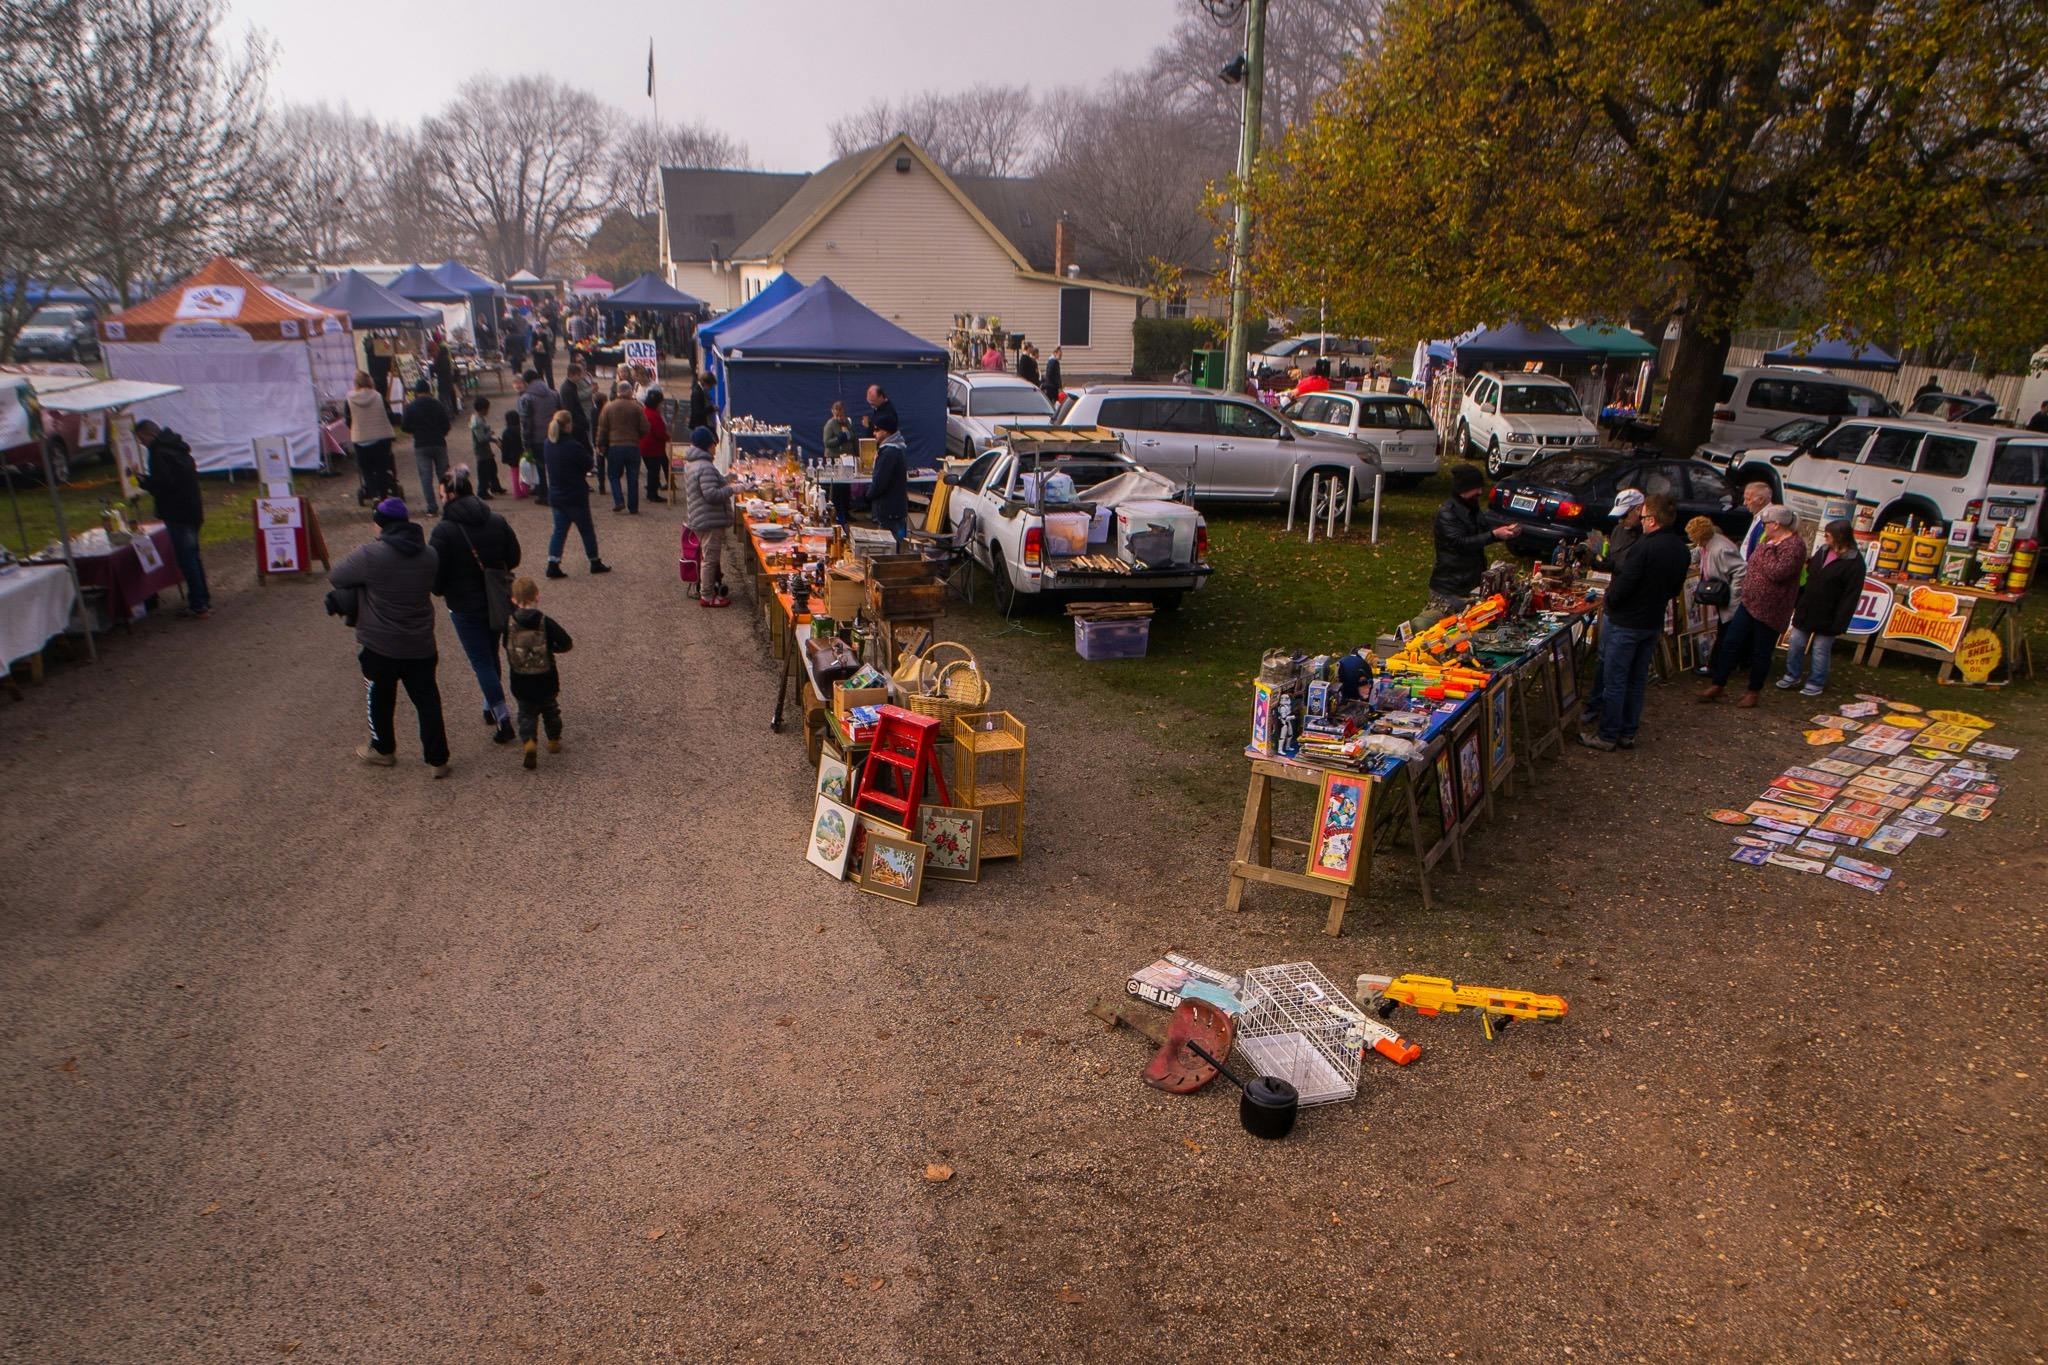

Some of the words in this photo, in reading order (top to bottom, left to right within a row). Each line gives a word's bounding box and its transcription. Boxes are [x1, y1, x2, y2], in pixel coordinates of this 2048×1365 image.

[627, 342, 656, 357] CAFE
[1889, 609, 1928, 637] GOLDEN
[1926, 622, 1961, 647] FLEECE
[1967, 644, 1996, 658] SHELL
